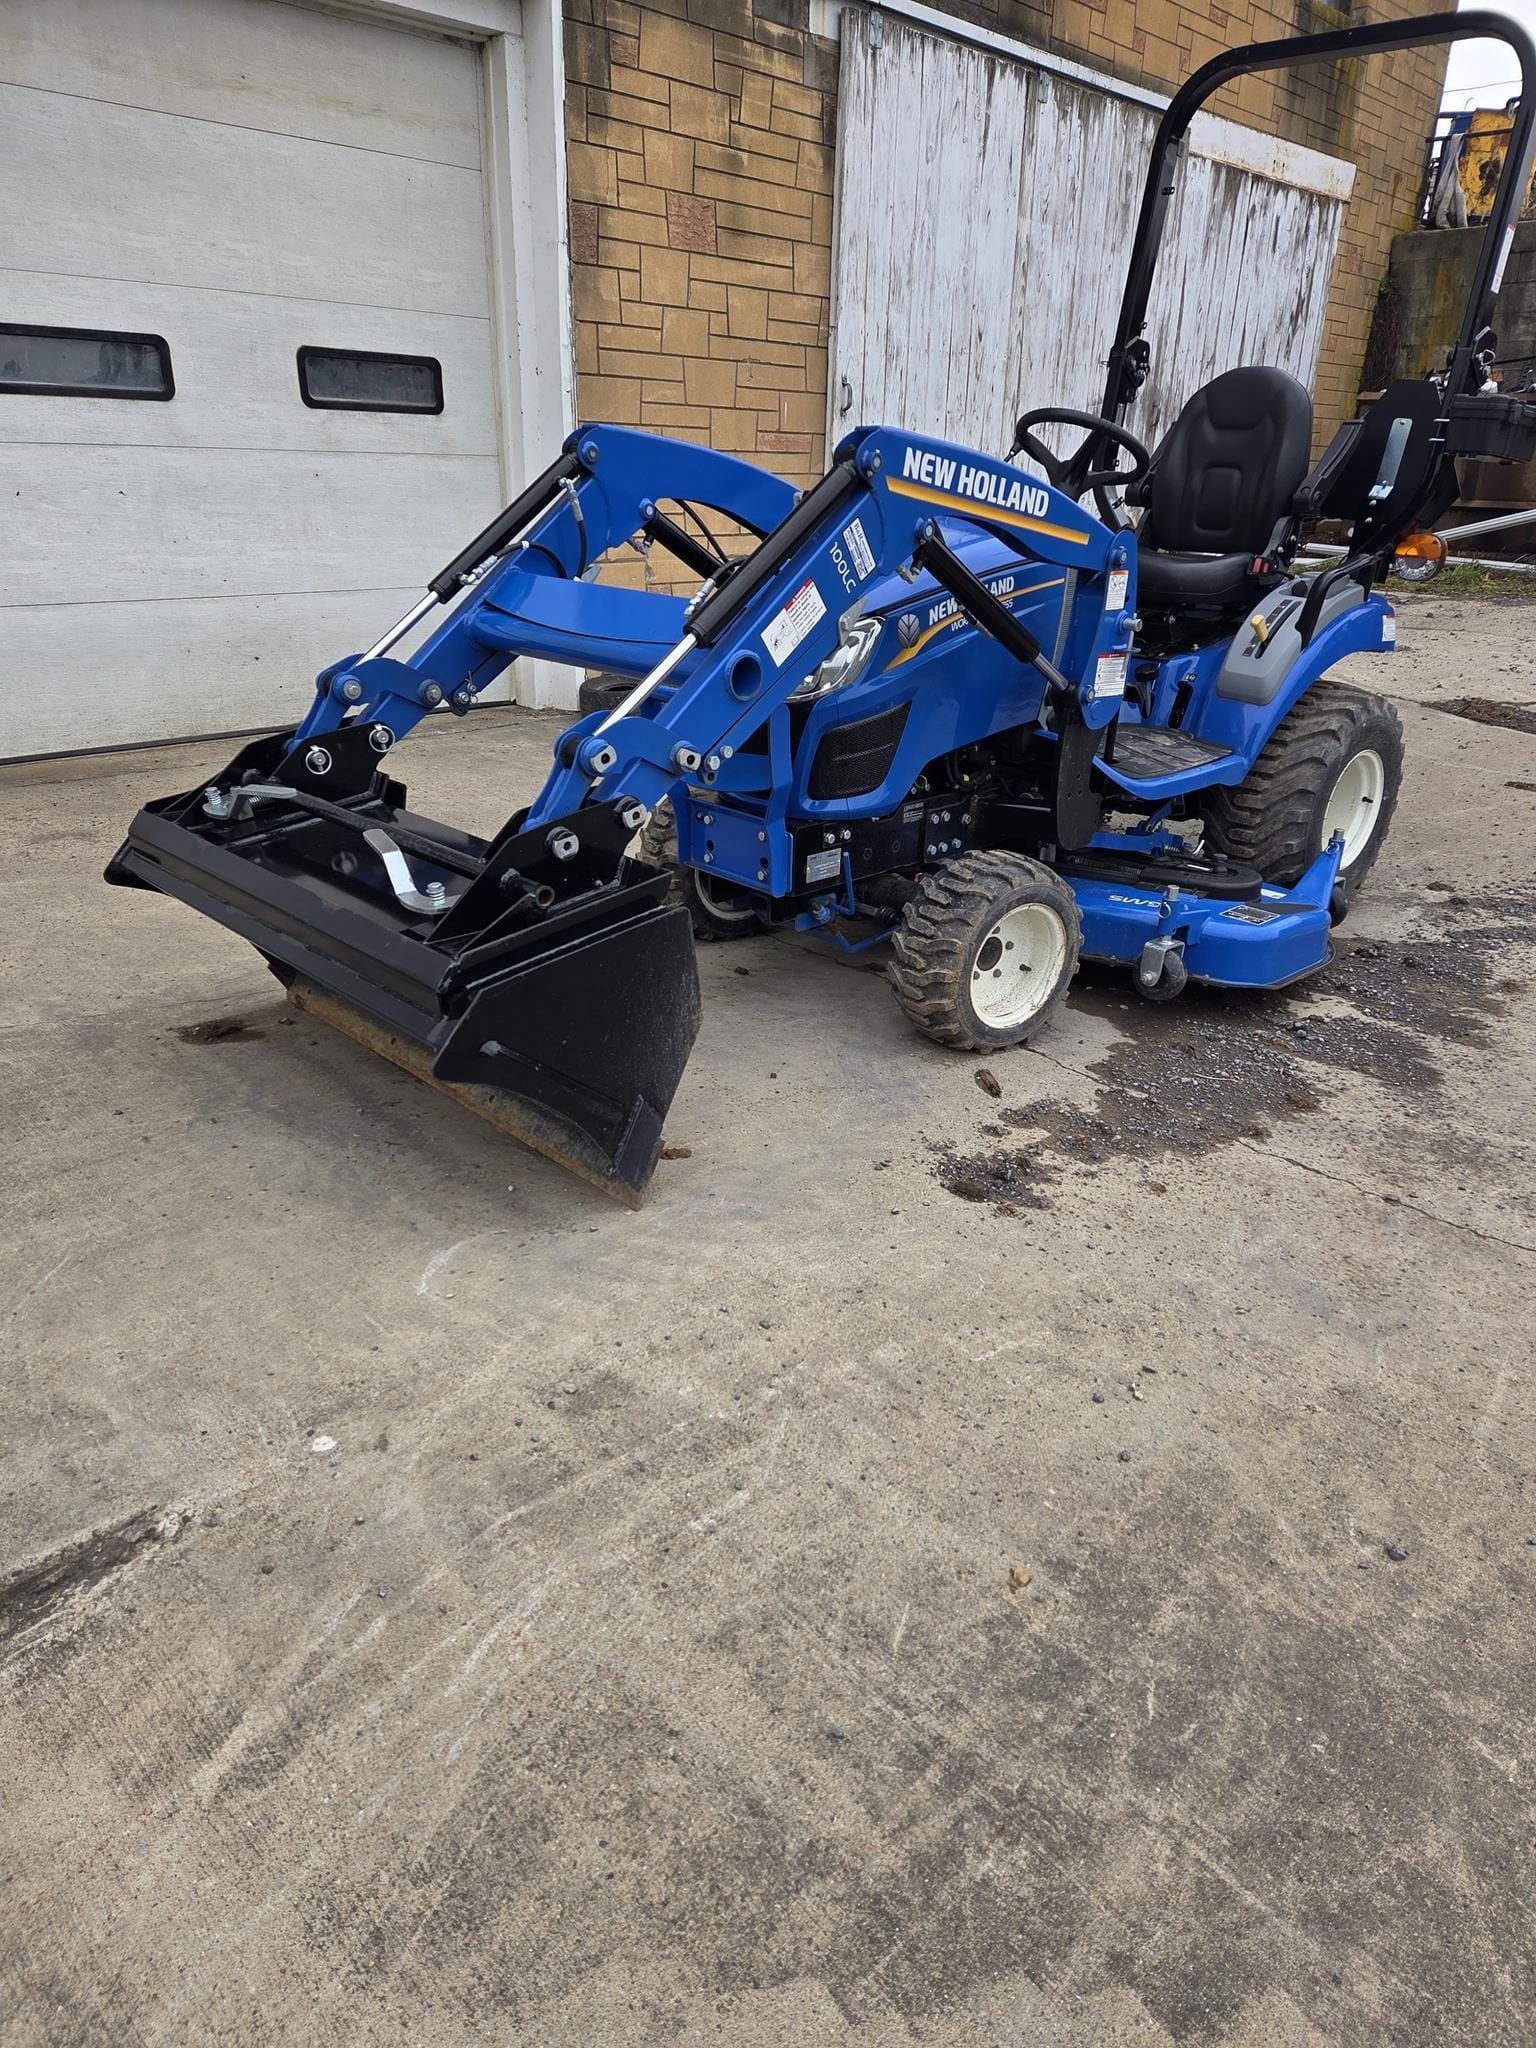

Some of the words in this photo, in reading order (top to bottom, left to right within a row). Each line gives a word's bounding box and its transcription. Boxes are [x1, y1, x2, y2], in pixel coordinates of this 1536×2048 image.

[903, 447, 957, 490] NEW
[957, 464, 1050, 518] HOLLAND
[829, 541, 857, 594] 100LC
[929, 597, 959, 626] NEW
